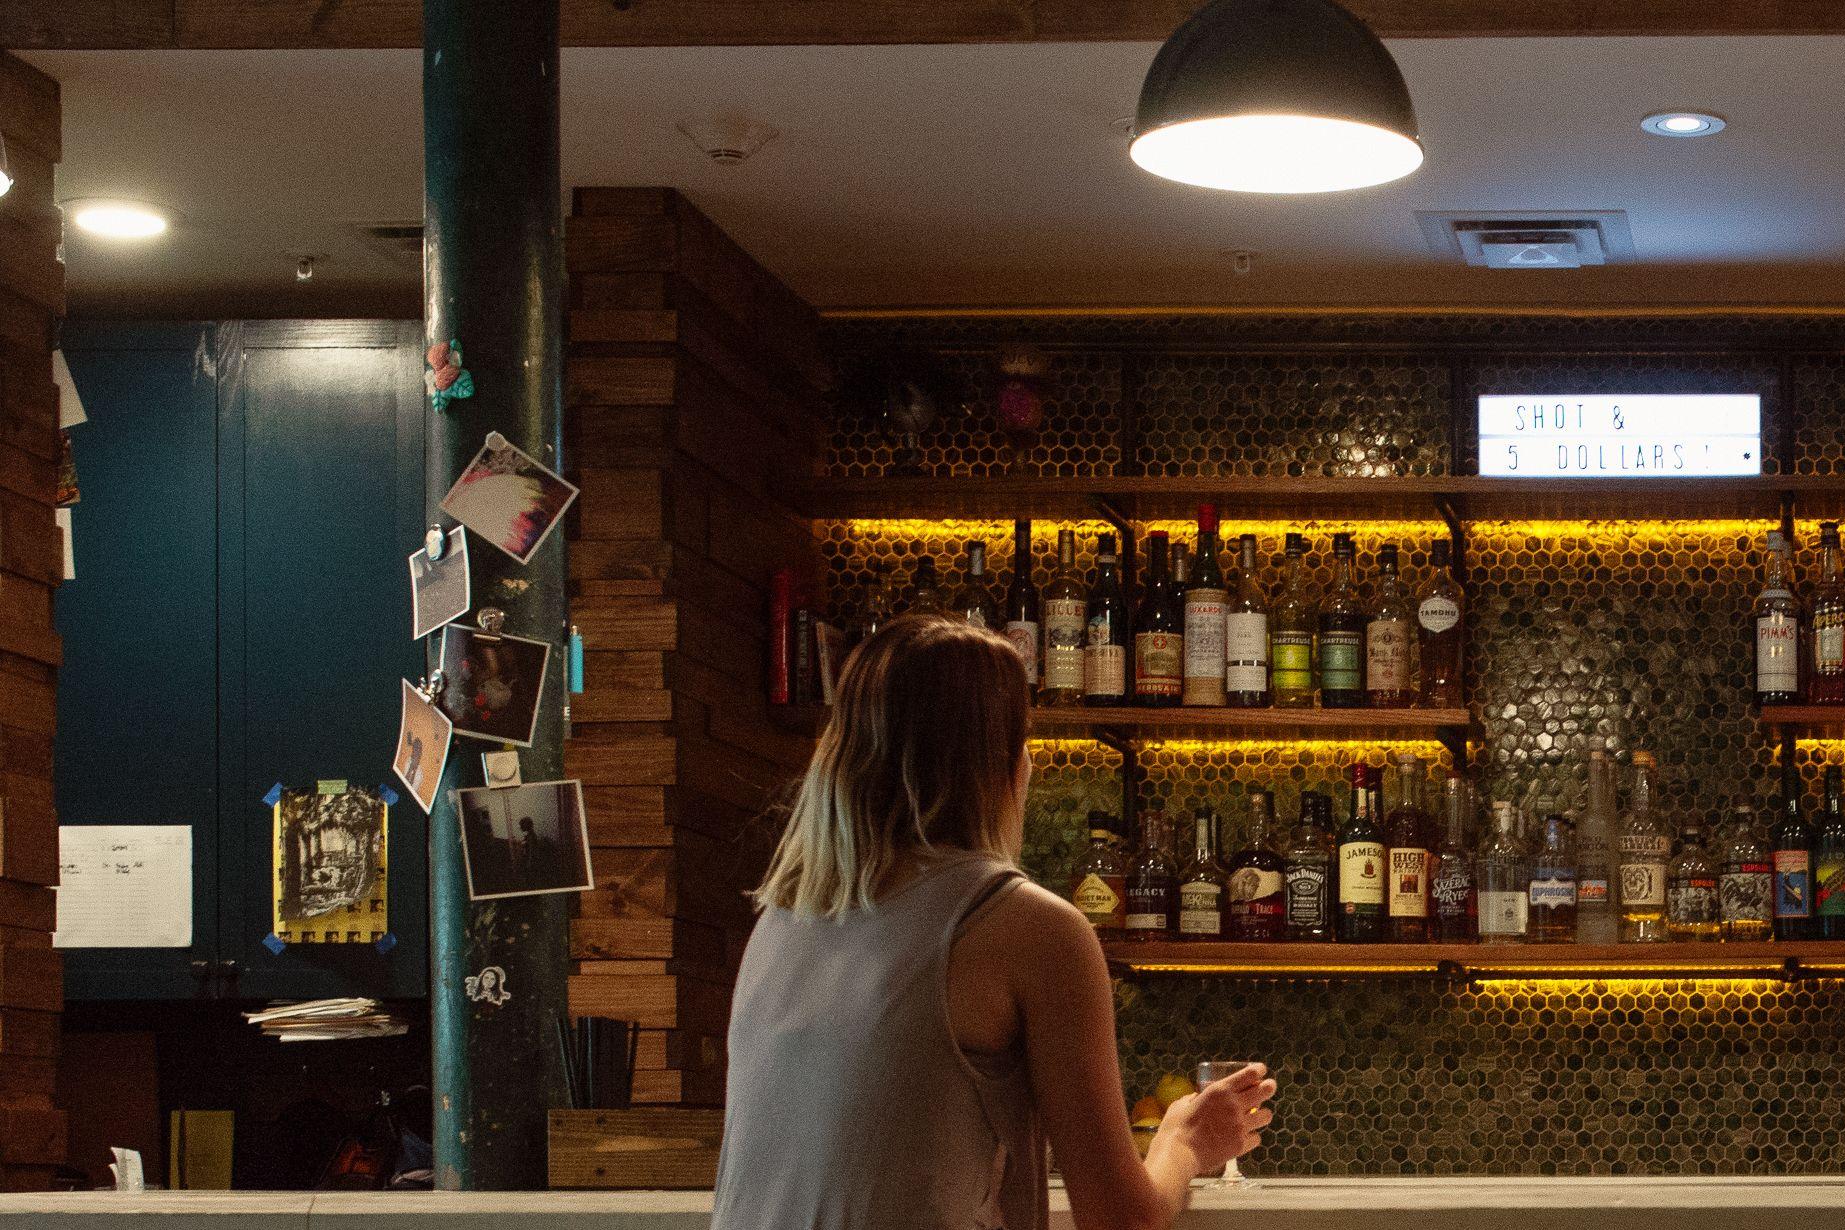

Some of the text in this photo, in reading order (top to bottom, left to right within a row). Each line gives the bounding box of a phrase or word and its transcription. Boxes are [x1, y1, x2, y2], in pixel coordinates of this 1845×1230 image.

[1515, 404, 1625, 430] SHOT &
[1508, 445, 1518, 470] 5
[1420, 609, 1457, 618] TAMDHU
[1760, 625, 1795, 640] PIMM'S
[1272, 637, 1311, 645] CHARTREUSE
[1320, 637, 1360, 645] CHARTREUSE
[1393, 852, 1424, 863] HIGH
[1286, 872, 1301, 883] JACK
[1432, 875, 1470, 898] SAZERAC
